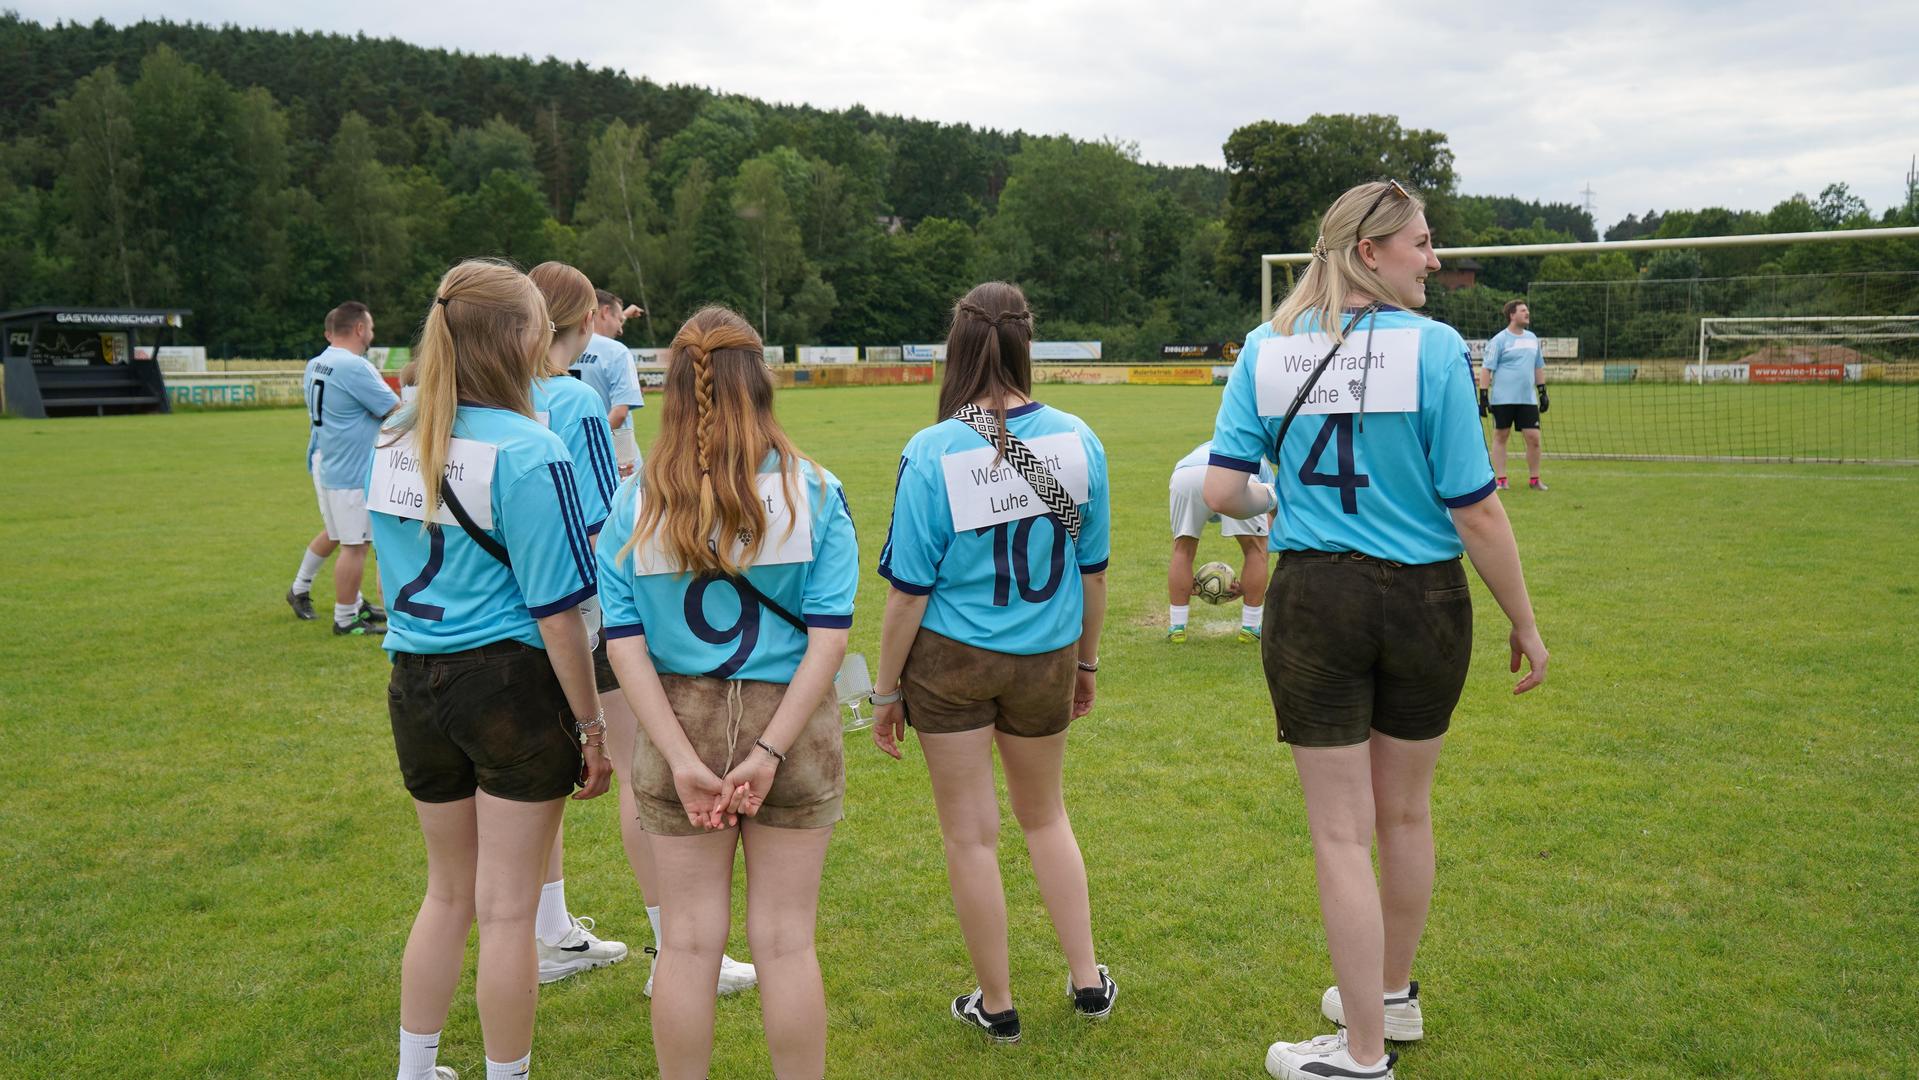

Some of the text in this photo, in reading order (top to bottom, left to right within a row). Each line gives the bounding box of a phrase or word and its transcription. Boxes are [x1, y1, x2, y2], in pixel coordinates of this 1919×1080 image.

[56, 313, 164, 324] GASTMANNSCHAFT
[389, 483, 423, 509] Luhe
[990, 493, 1029, 514] Luhe
[1298, 412, 1370, 514] 4
[393, 514, 446, 622] 2
[975, 511, 1066, 607] 10
[683, 568, 760, 679] 9
